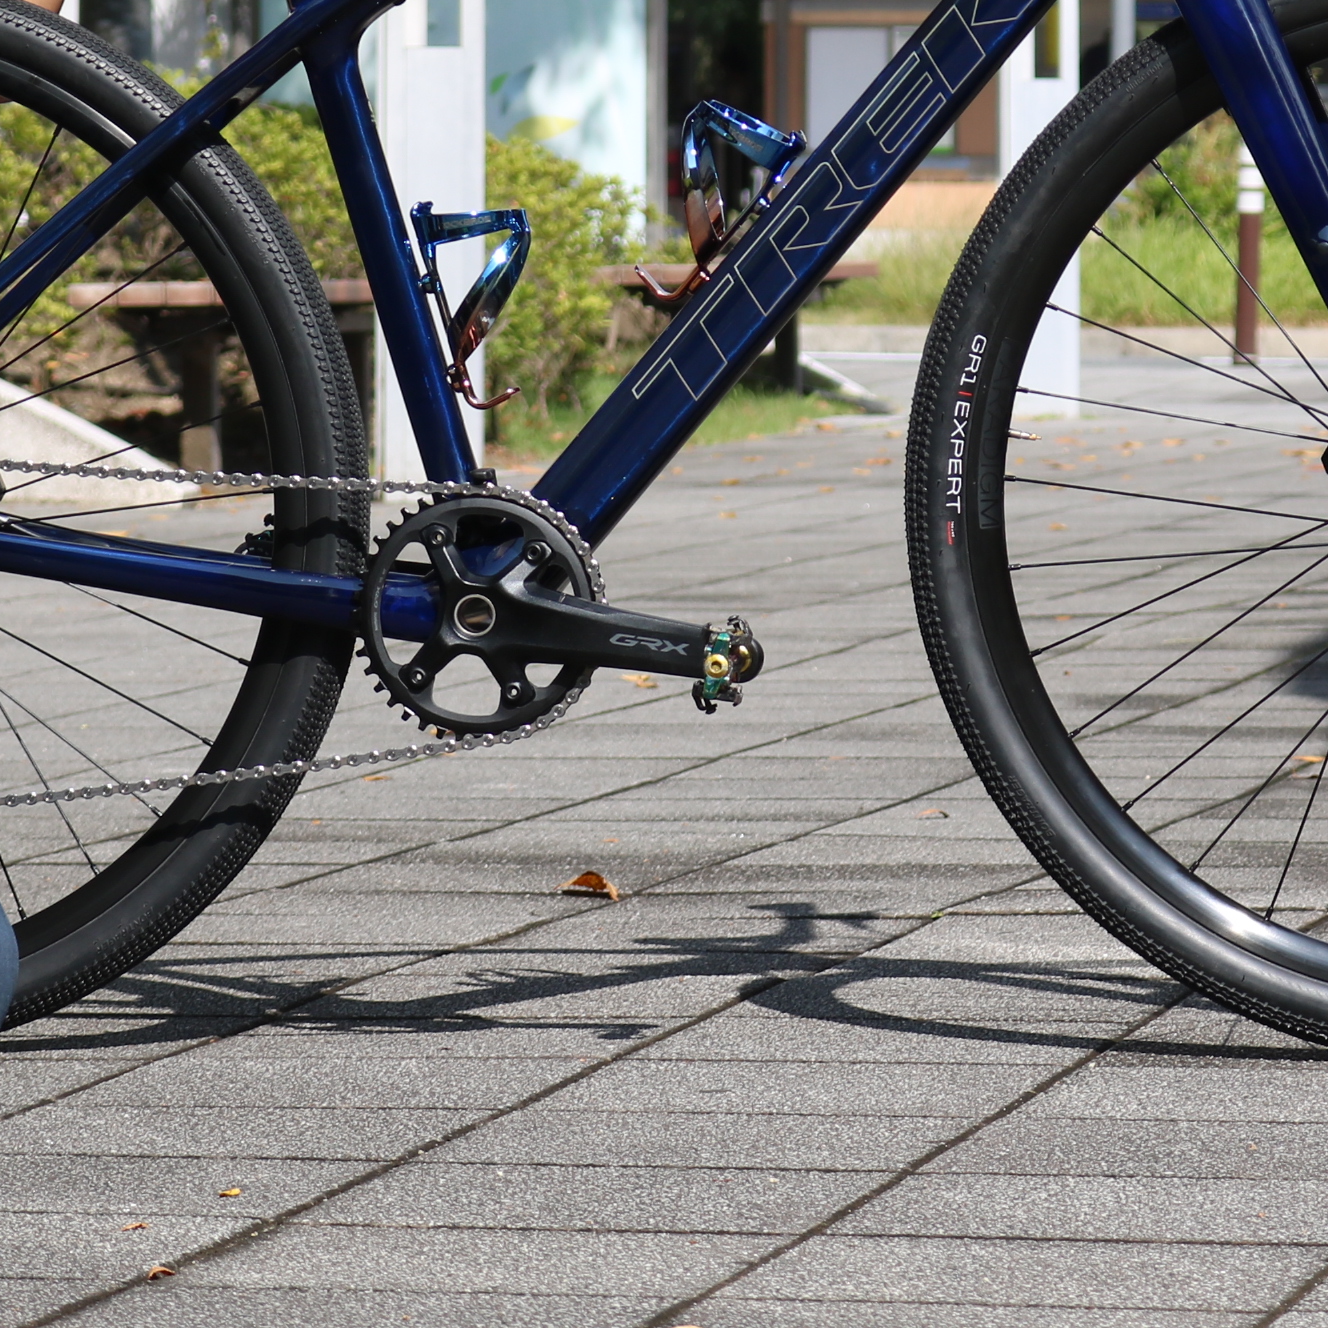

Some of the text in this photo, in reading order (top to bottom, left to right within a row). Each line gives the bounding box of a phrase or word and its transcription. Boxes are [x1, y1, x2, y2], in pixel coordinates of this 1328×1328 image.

[945, 334, 988, 514] GR1 EXPERT
[609, 633, 691, 656] GRX
